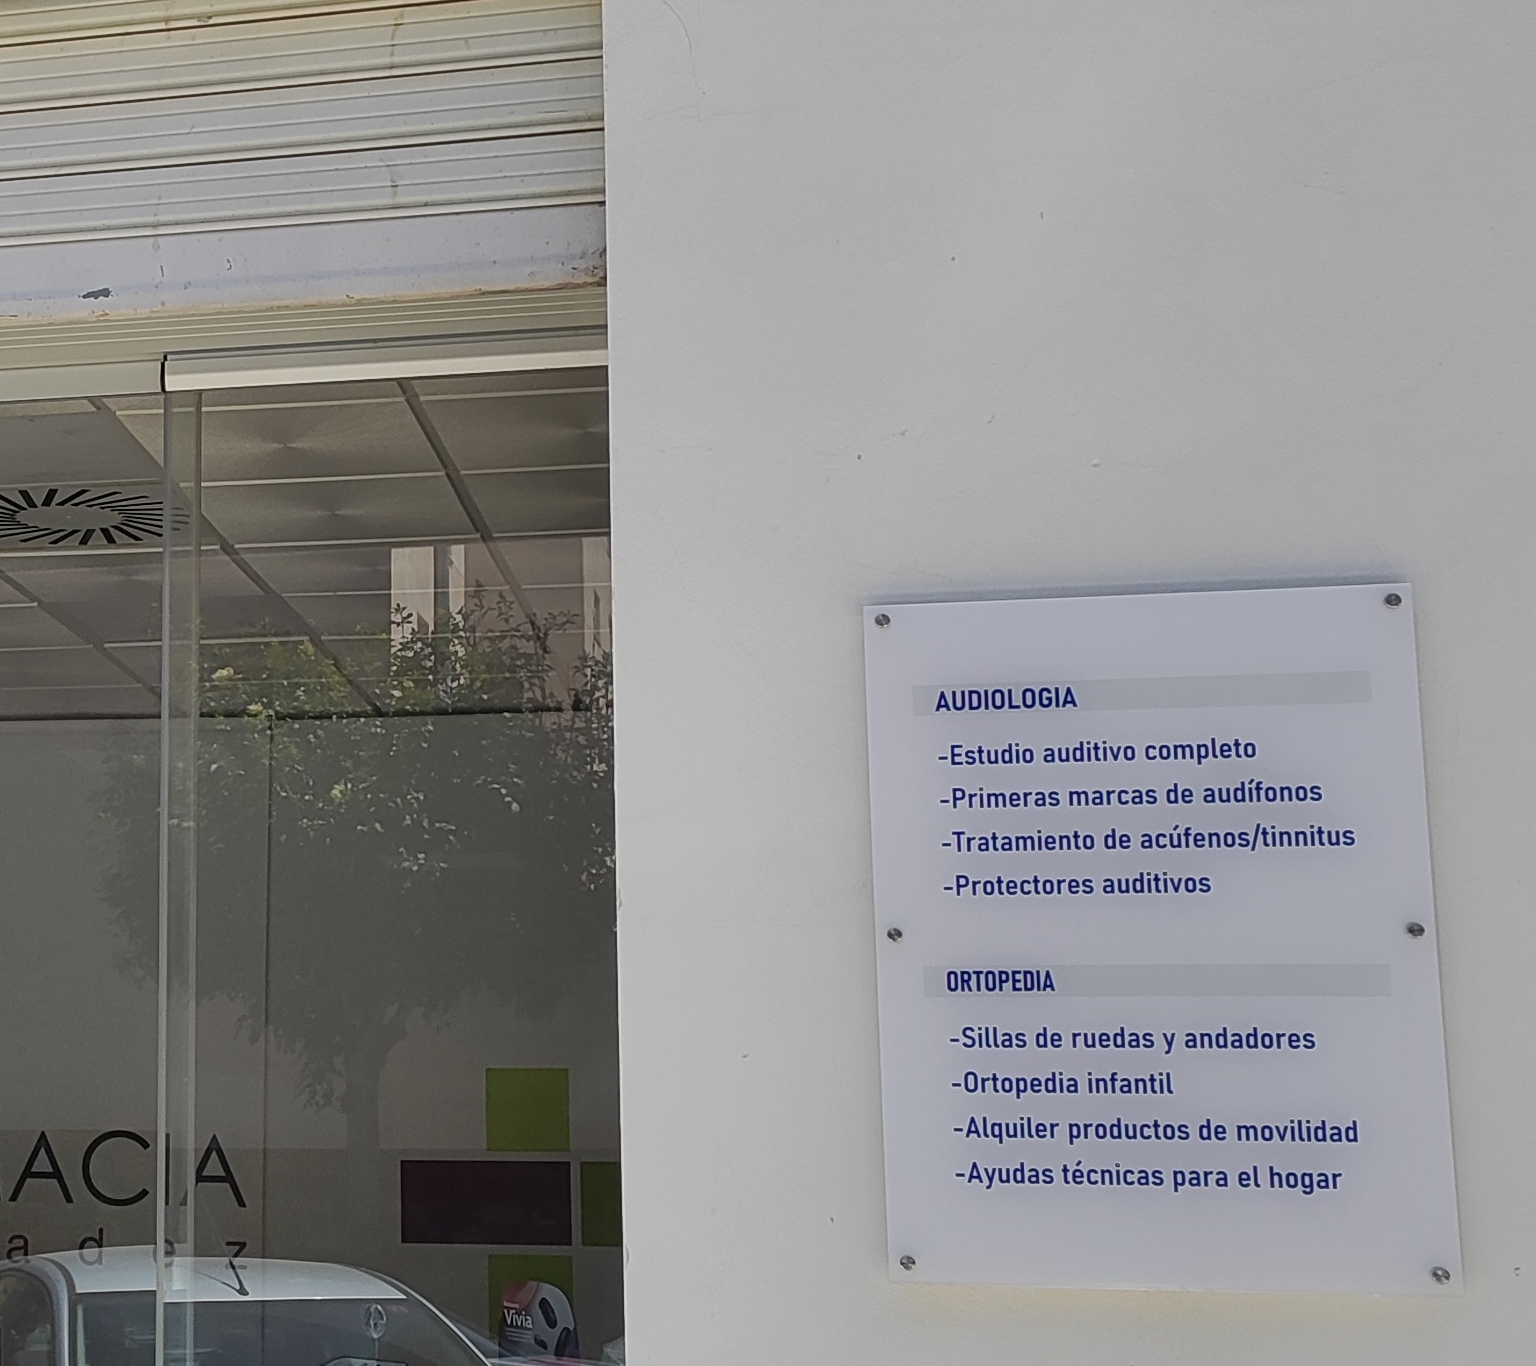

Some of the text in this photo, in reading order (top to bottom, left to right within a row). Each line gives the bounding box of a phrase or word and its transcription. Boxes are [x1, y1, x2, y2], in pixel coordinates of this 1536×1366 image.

[935, 686, 1078, 712] AUDIOLOGIA
[938, 737, 1257, 766] -Estudio auditivo completo
[940, 778, 1324, 809] -Primeras marcas de audífonos
[941, 823, 1356, 852] -Tratamiento de acúfenos/tinnitus
[943, 871, 1213, 897] -Protectores auditivos
[946, 969, 1056, 993] ORTOPEDIA
[950, 1026, 1317, 1055] -Sillas de ruedas y andadores
[951, 1071, 1174, 1100] -Ortopedia infantil
[953, 1116, 1359, 1146] -Alquiler productos de movilidad
[955, 1160, 1343, 1196] -Ayudas técnicas para el hogar
[503, 1309, 533, 1329] Vivia
